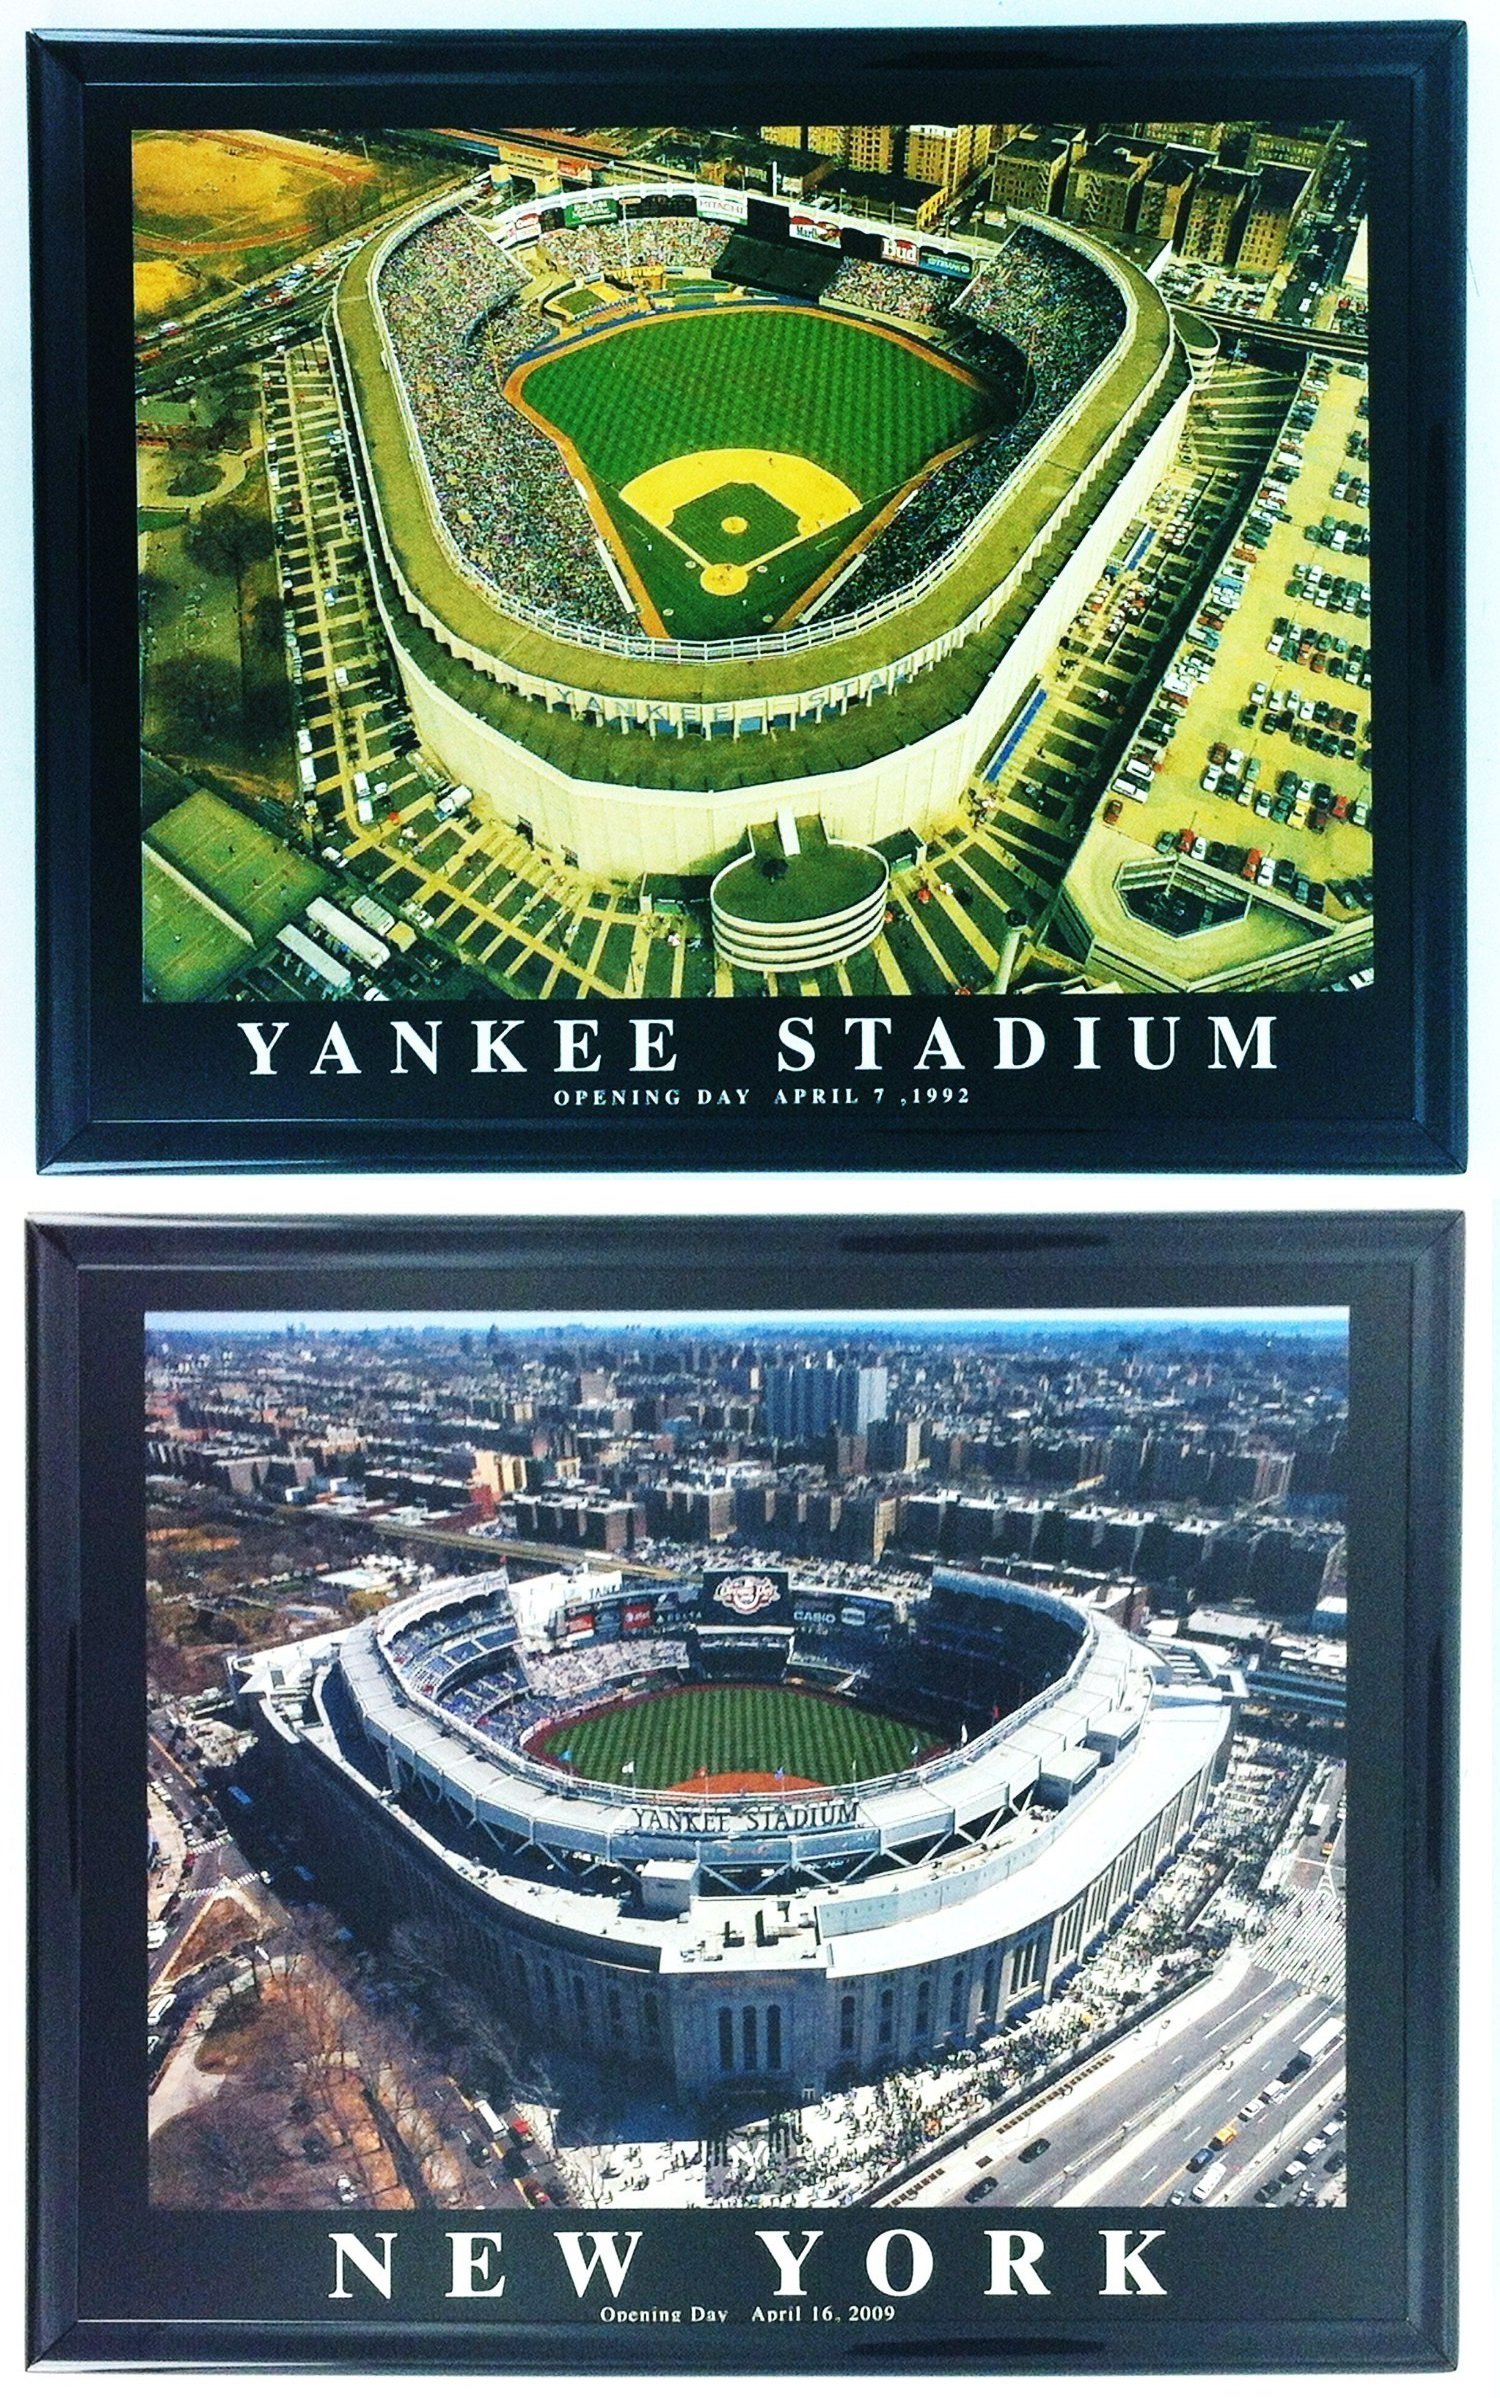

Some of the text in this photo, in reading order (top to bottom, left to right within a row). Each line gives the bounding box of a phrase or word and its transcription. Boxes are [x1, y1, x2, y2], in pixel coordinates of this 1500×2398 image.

[882, 238, 917, 261] Bud
[555, 686, 729, 721] YANKEE
[237, 1017, 1277, 1074] YANKEE STADIUM
[554, 1090, 679, 1106] OPENING
[698, 1089, 749, 1105] DAY
[775, 1089, 858, 1104] APRIL
[874, 1088, 884, 1103] 7
[793, 1611, 836, 1624] CASIO
[632, 1802, 859, 1833] YANKEE STADIUM
[328, 2229, 1167, 2299] NEW YORK
[600, 2306, 895, 2323] Opening Day April 16, 2009
